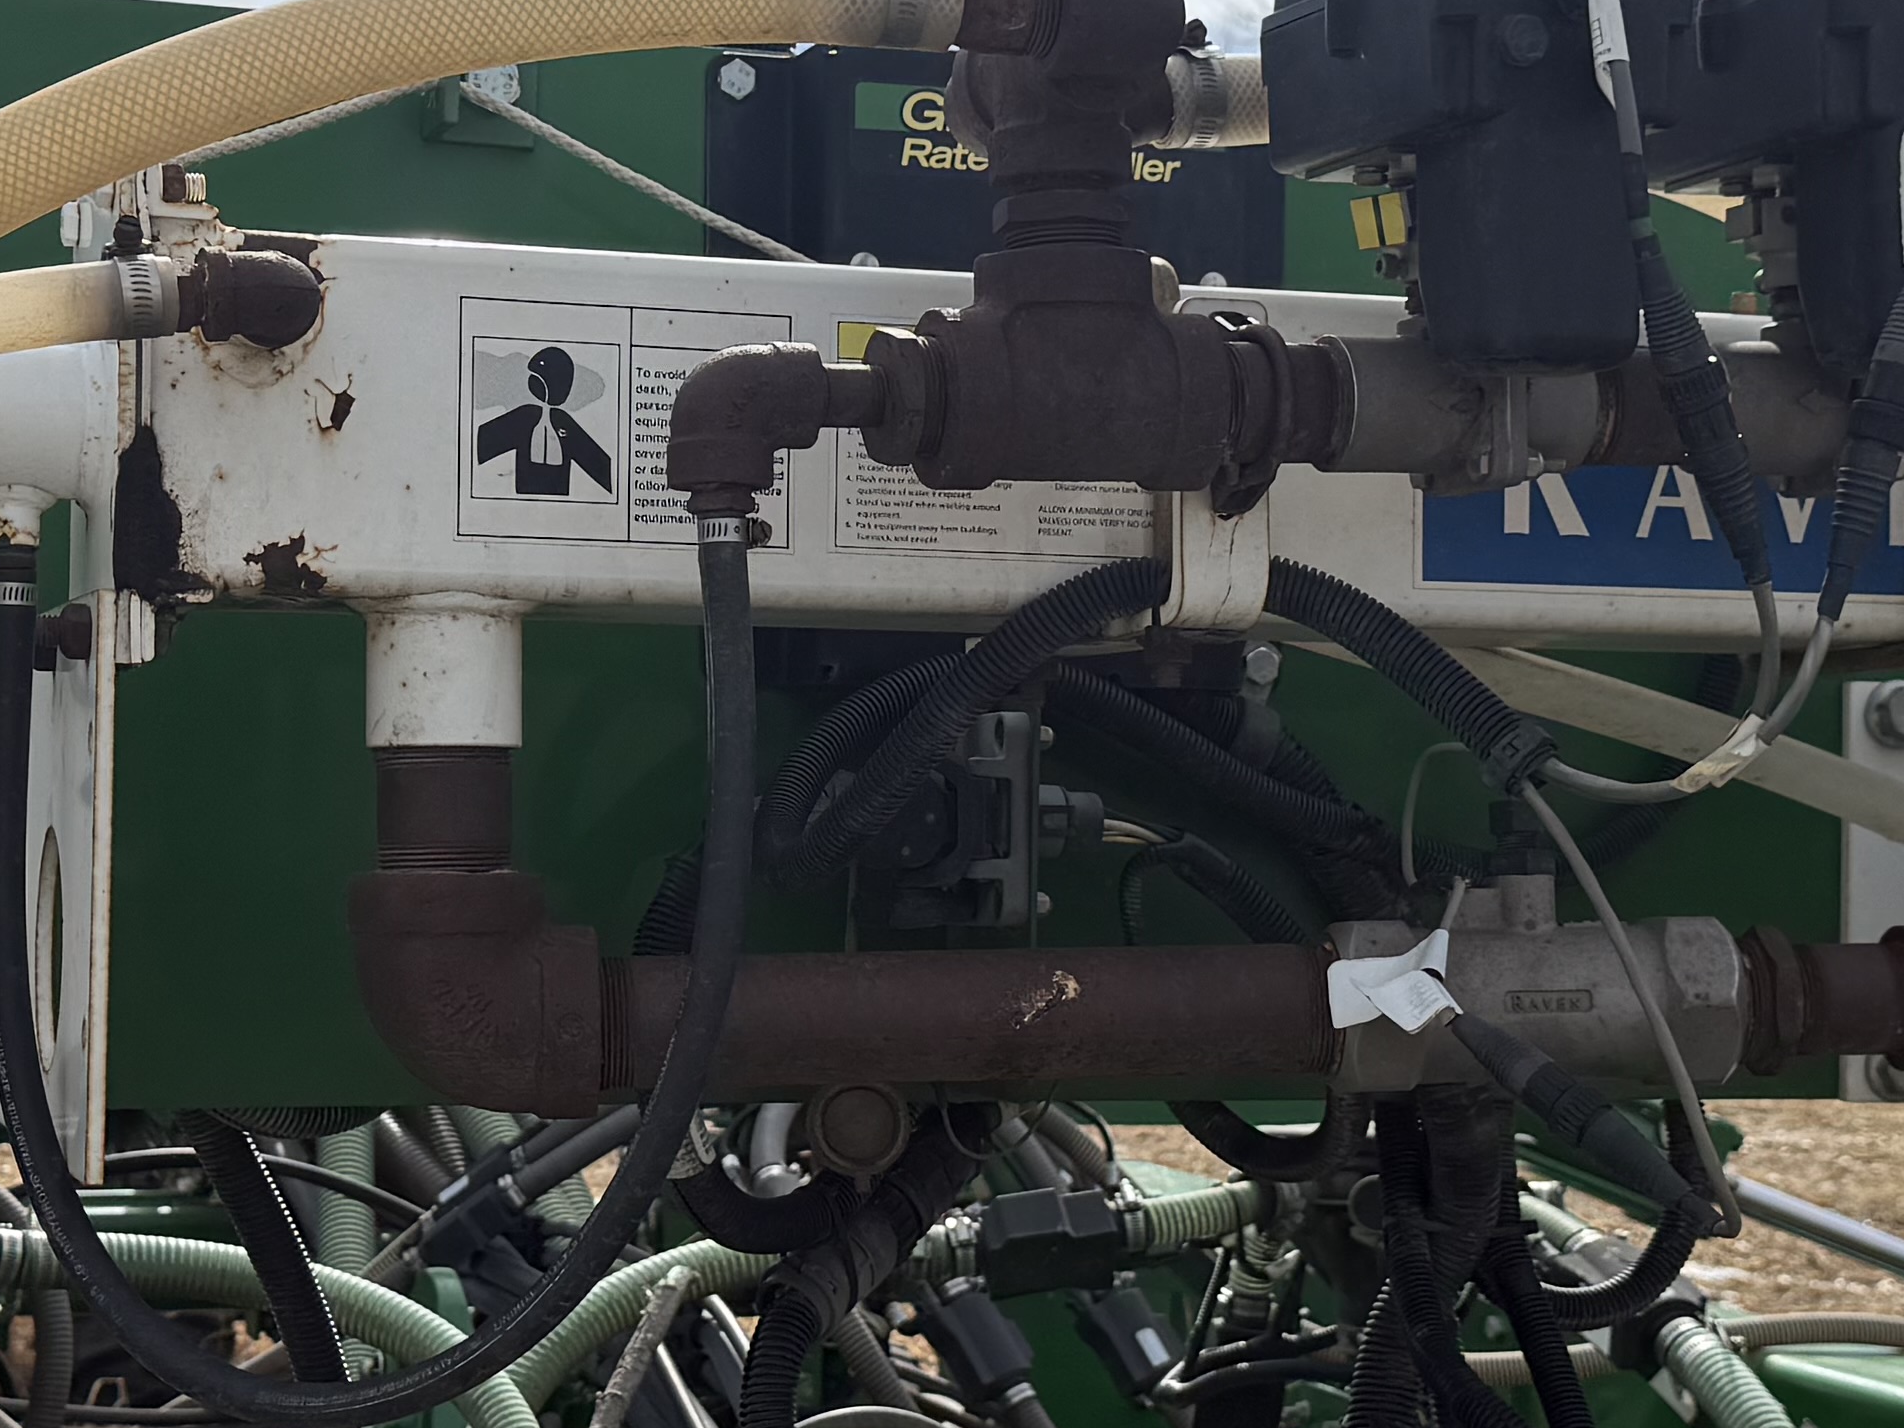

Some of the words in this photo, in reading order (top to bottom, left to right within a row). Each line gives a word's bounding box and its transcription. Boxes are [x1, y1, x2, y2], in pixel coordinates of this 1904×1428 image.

[901, 137, 989, 172] Rate
[635, 367, 651, 378] To
[654, 369, 686, 380] avoid
[635, 417, 668, 430] equip
